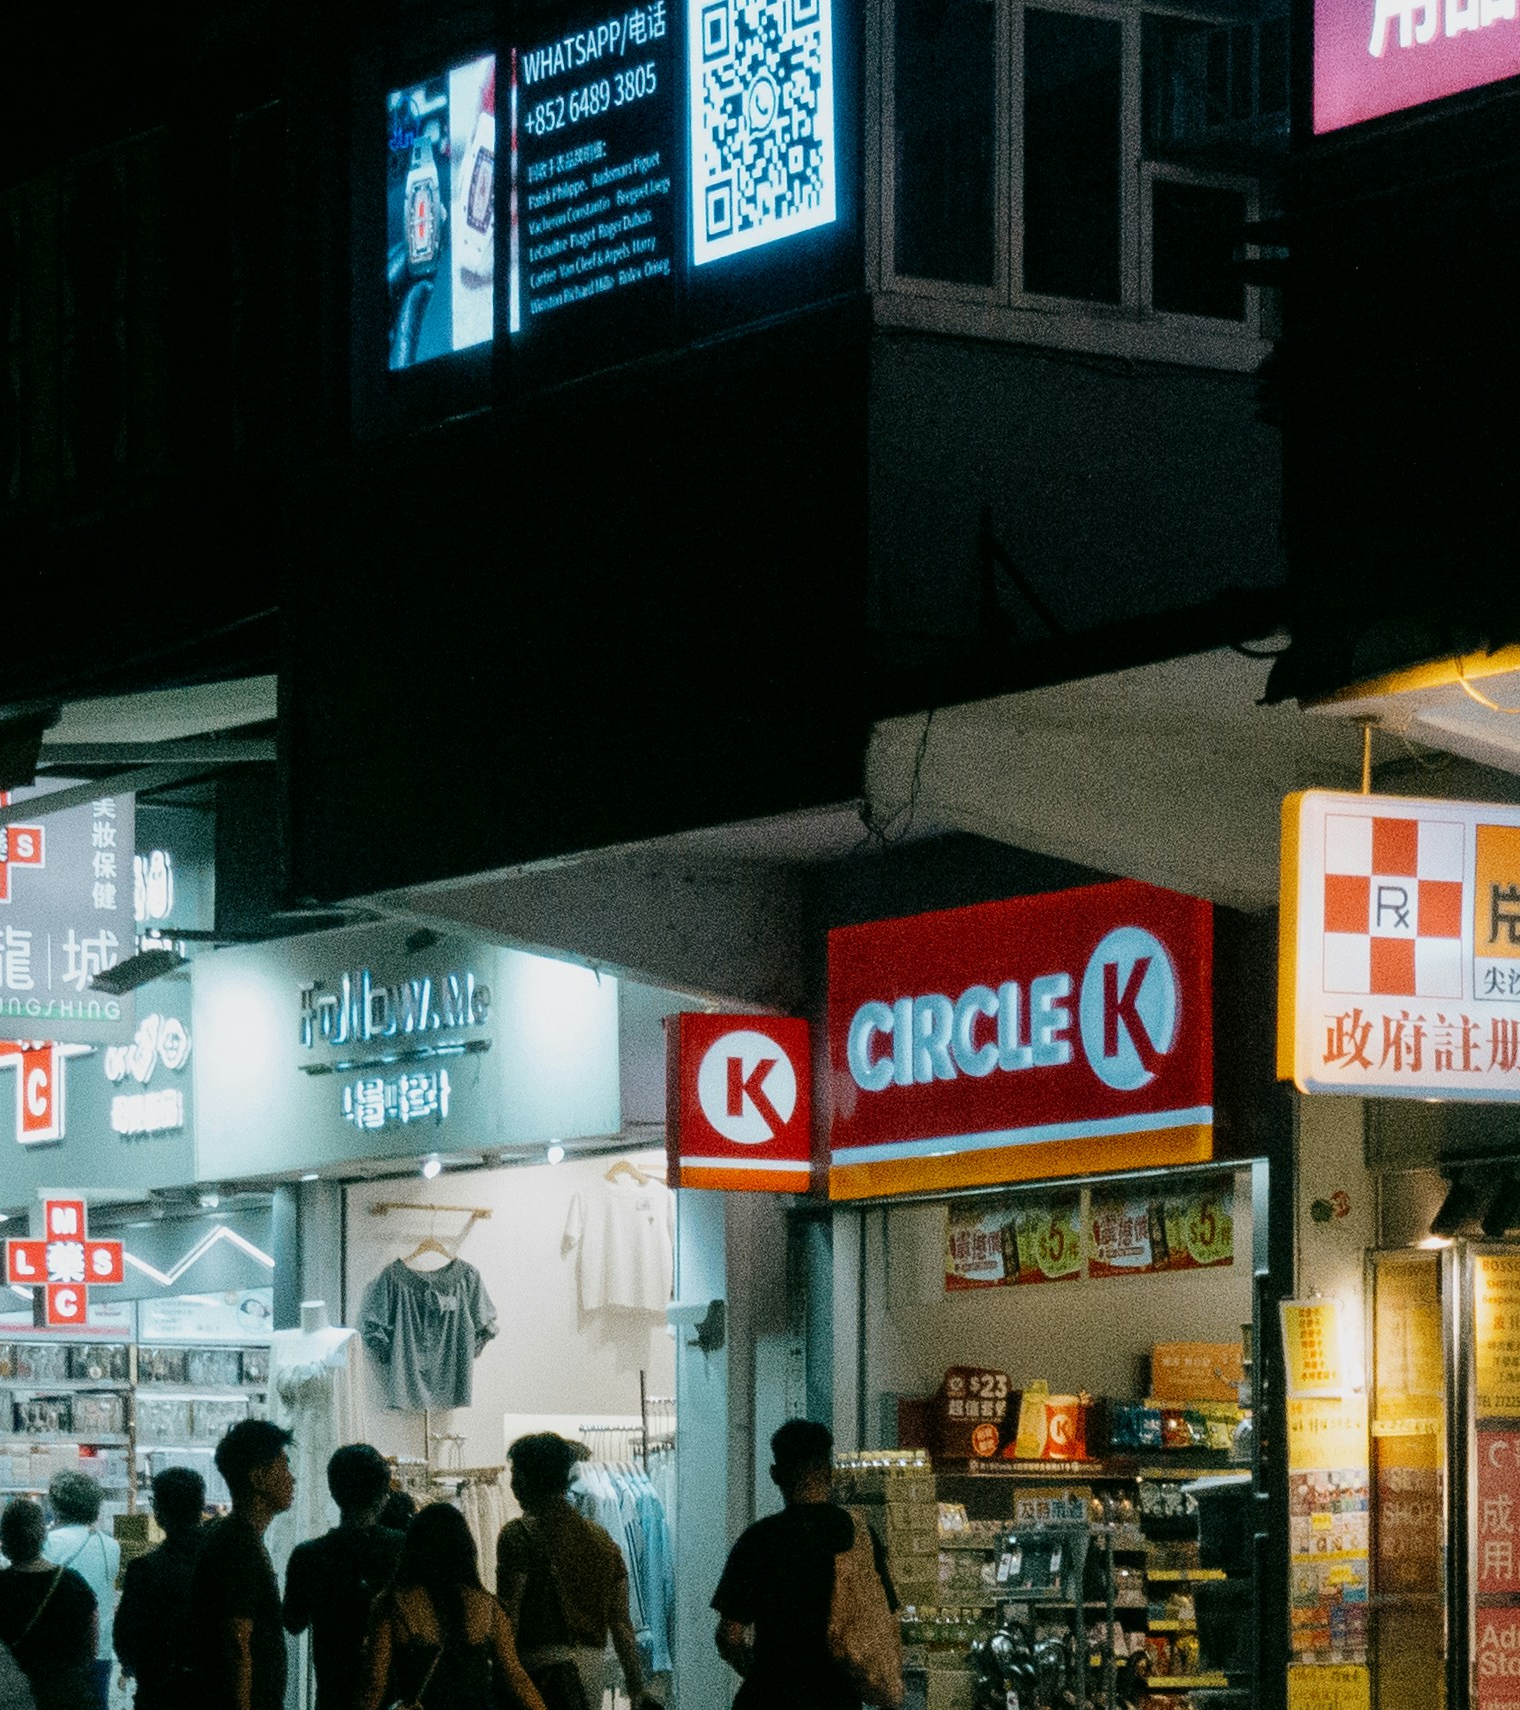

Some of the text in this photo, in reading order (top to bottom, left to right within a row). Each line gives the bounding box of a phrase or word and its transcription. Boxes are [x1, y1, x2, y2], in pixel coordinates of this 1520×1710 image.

[525, 62, 656, 135] +852 6489 3805
[16, 834, 34, 857] S
[847, 956, 1158, 1092] CIRCLE K
[726, 1057, 787, 1137] K
[51, 1207, 77, 1235] M
[17, 1251, 35, 1275] L
[93, 1250, 113, 1275] S
[54, 1289, 78, 1318] C
